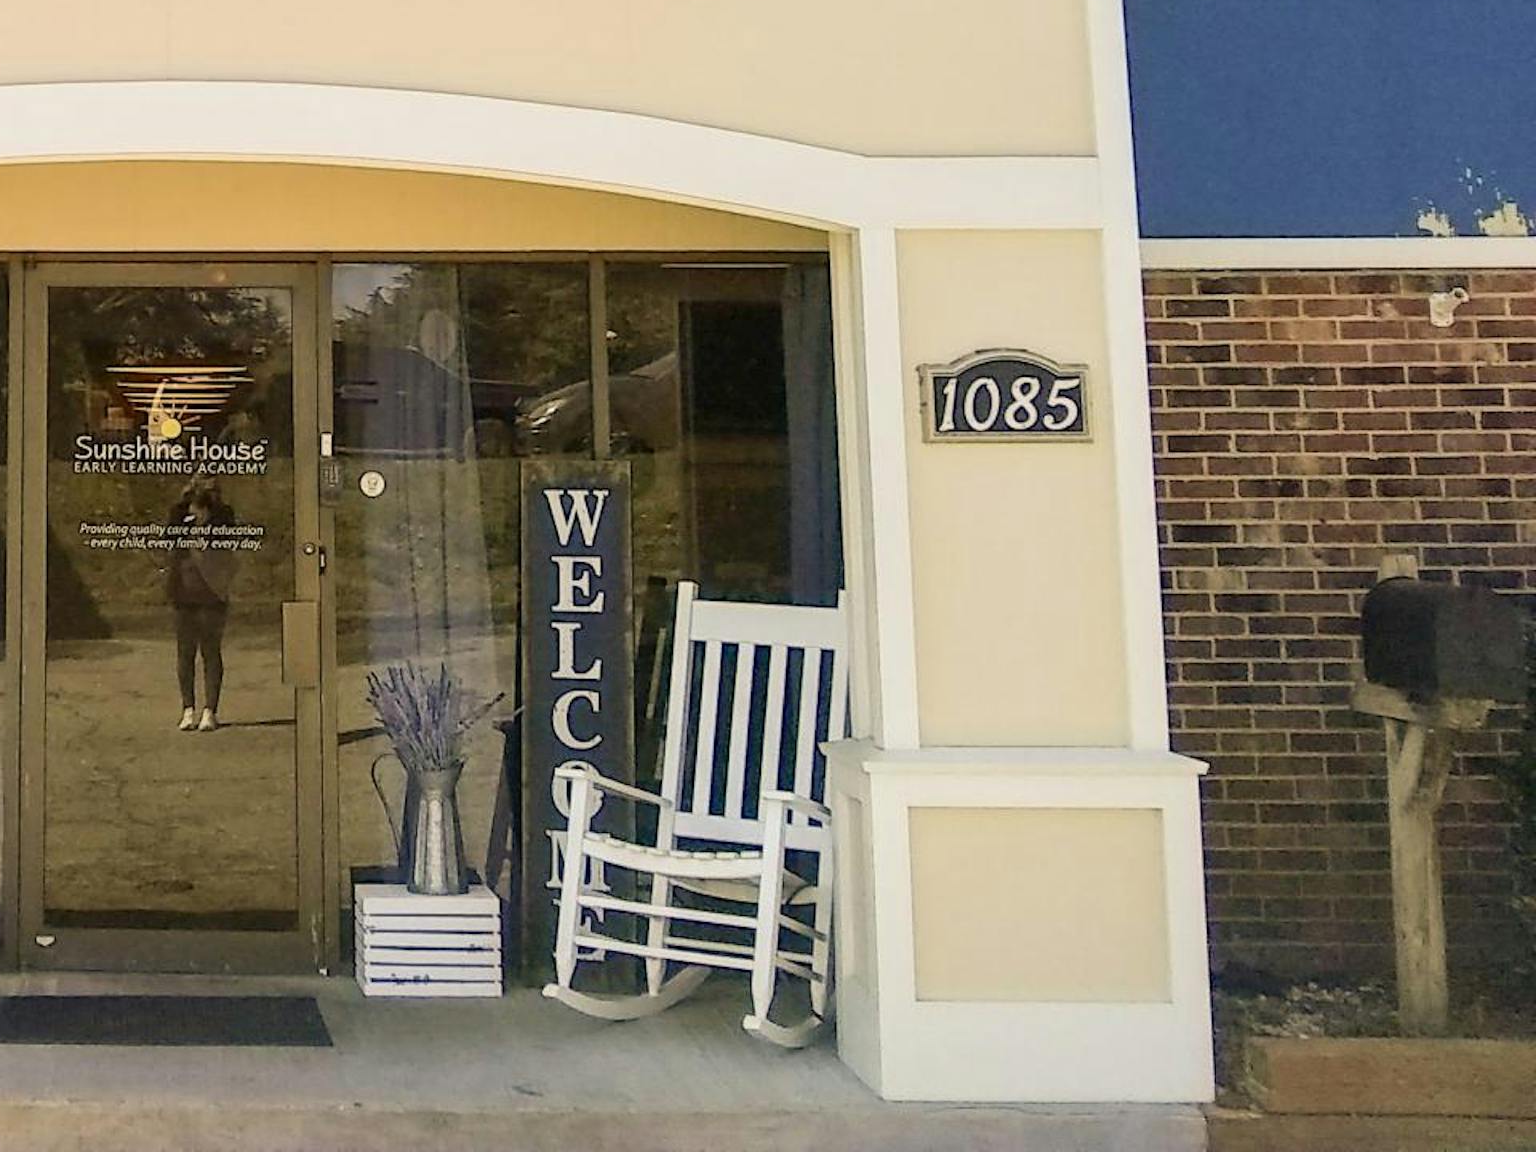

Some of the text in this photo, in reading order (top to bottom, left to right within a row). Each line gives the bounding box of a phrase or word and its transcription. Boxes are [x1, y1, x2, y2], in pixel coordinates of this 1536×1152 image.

[938, 376, 1081, 432] 1085
[74, 435, 265, 461] Sunshine House
[74, 462, 267, 474] EARLY LEARNING ACADEMY
[79, 523, 264, 537] Providing quality care and education
[90, 540, 118, 550] every
[147, 540, 175, 550] every
[211, 540, 240, 550] every
